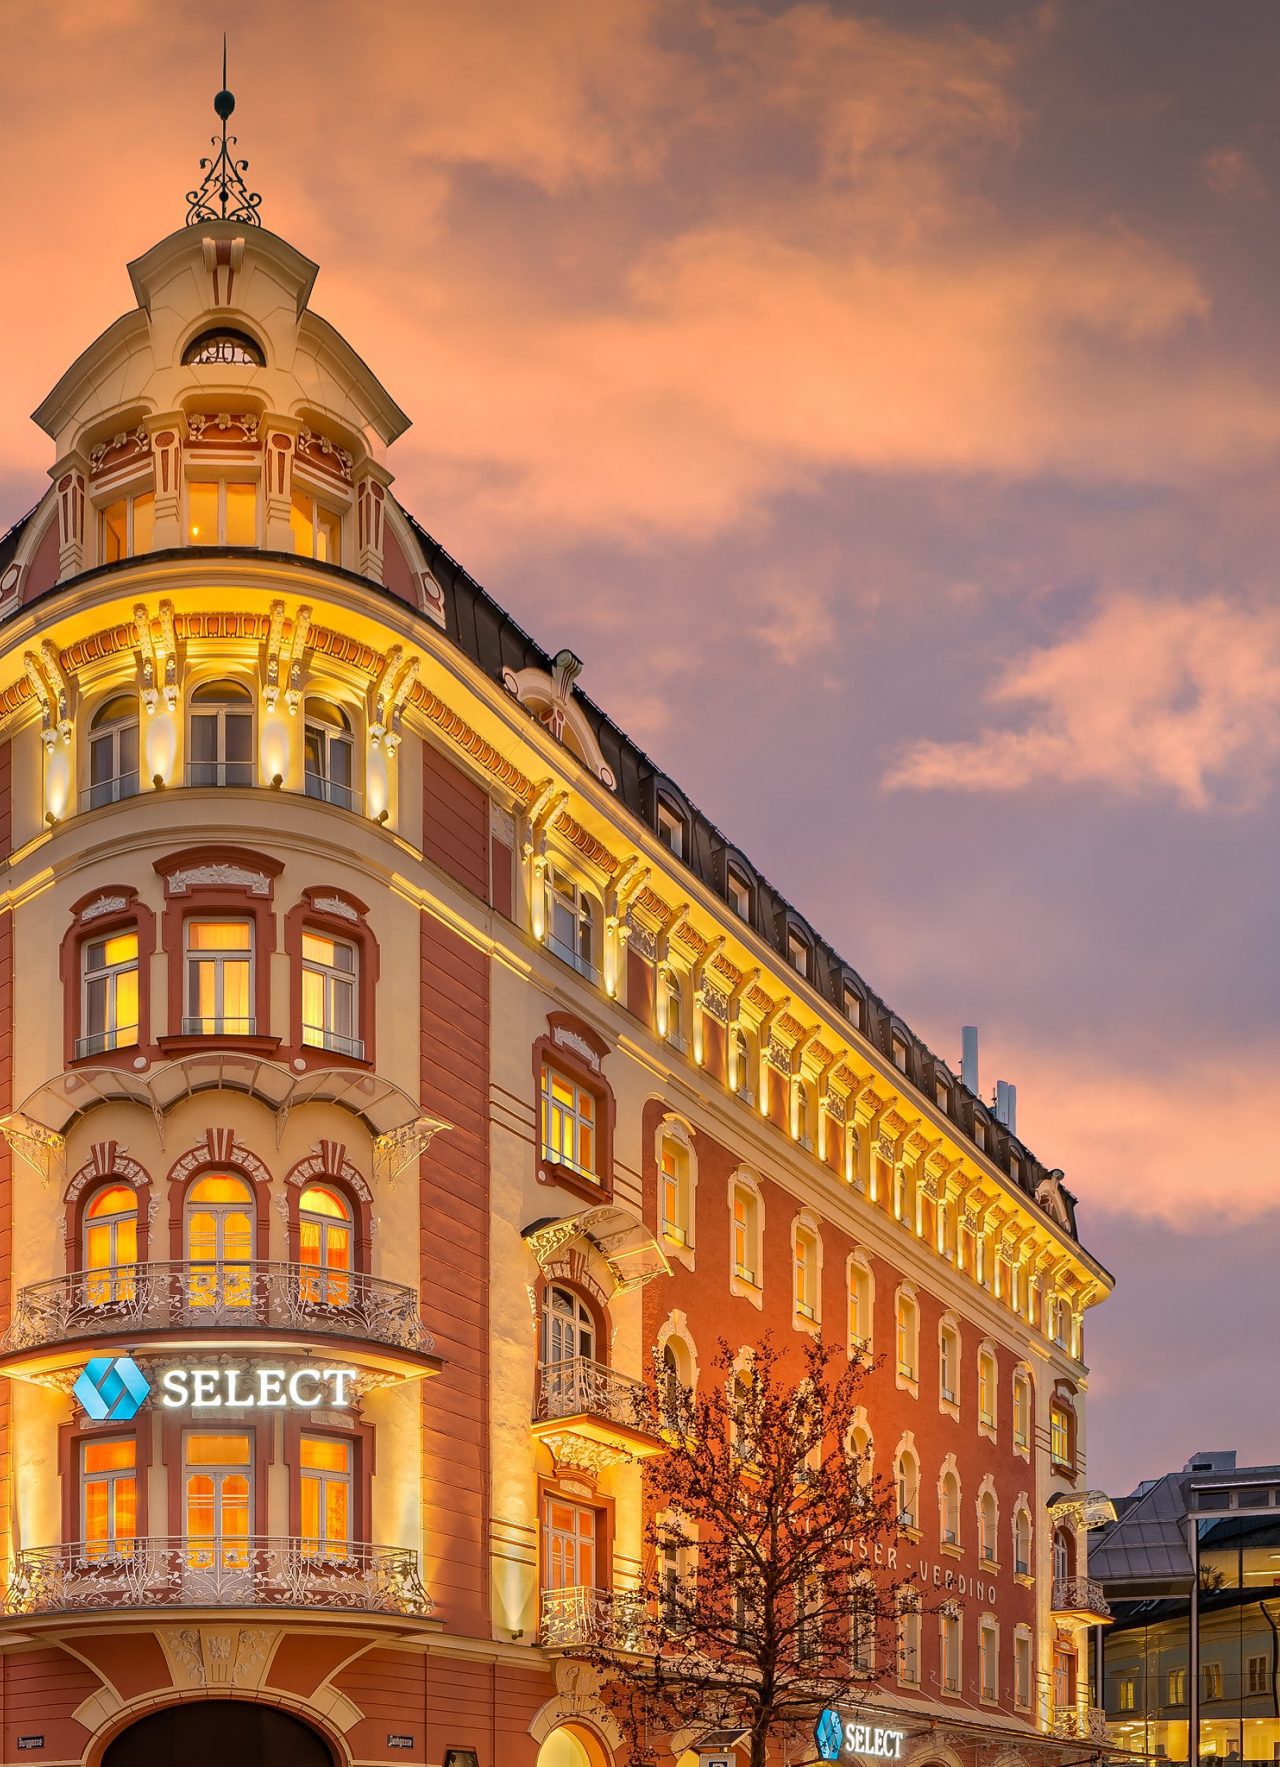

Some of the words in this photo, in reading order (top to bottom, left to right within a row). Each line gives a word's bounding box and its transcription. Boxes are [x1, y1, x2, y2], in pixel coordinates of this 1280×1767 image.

[162, 1368, 357, 1408] SELECT
[919, 1560, 996, 1605] VERDINO
[845, 1723, 904, 1758] SELECT
